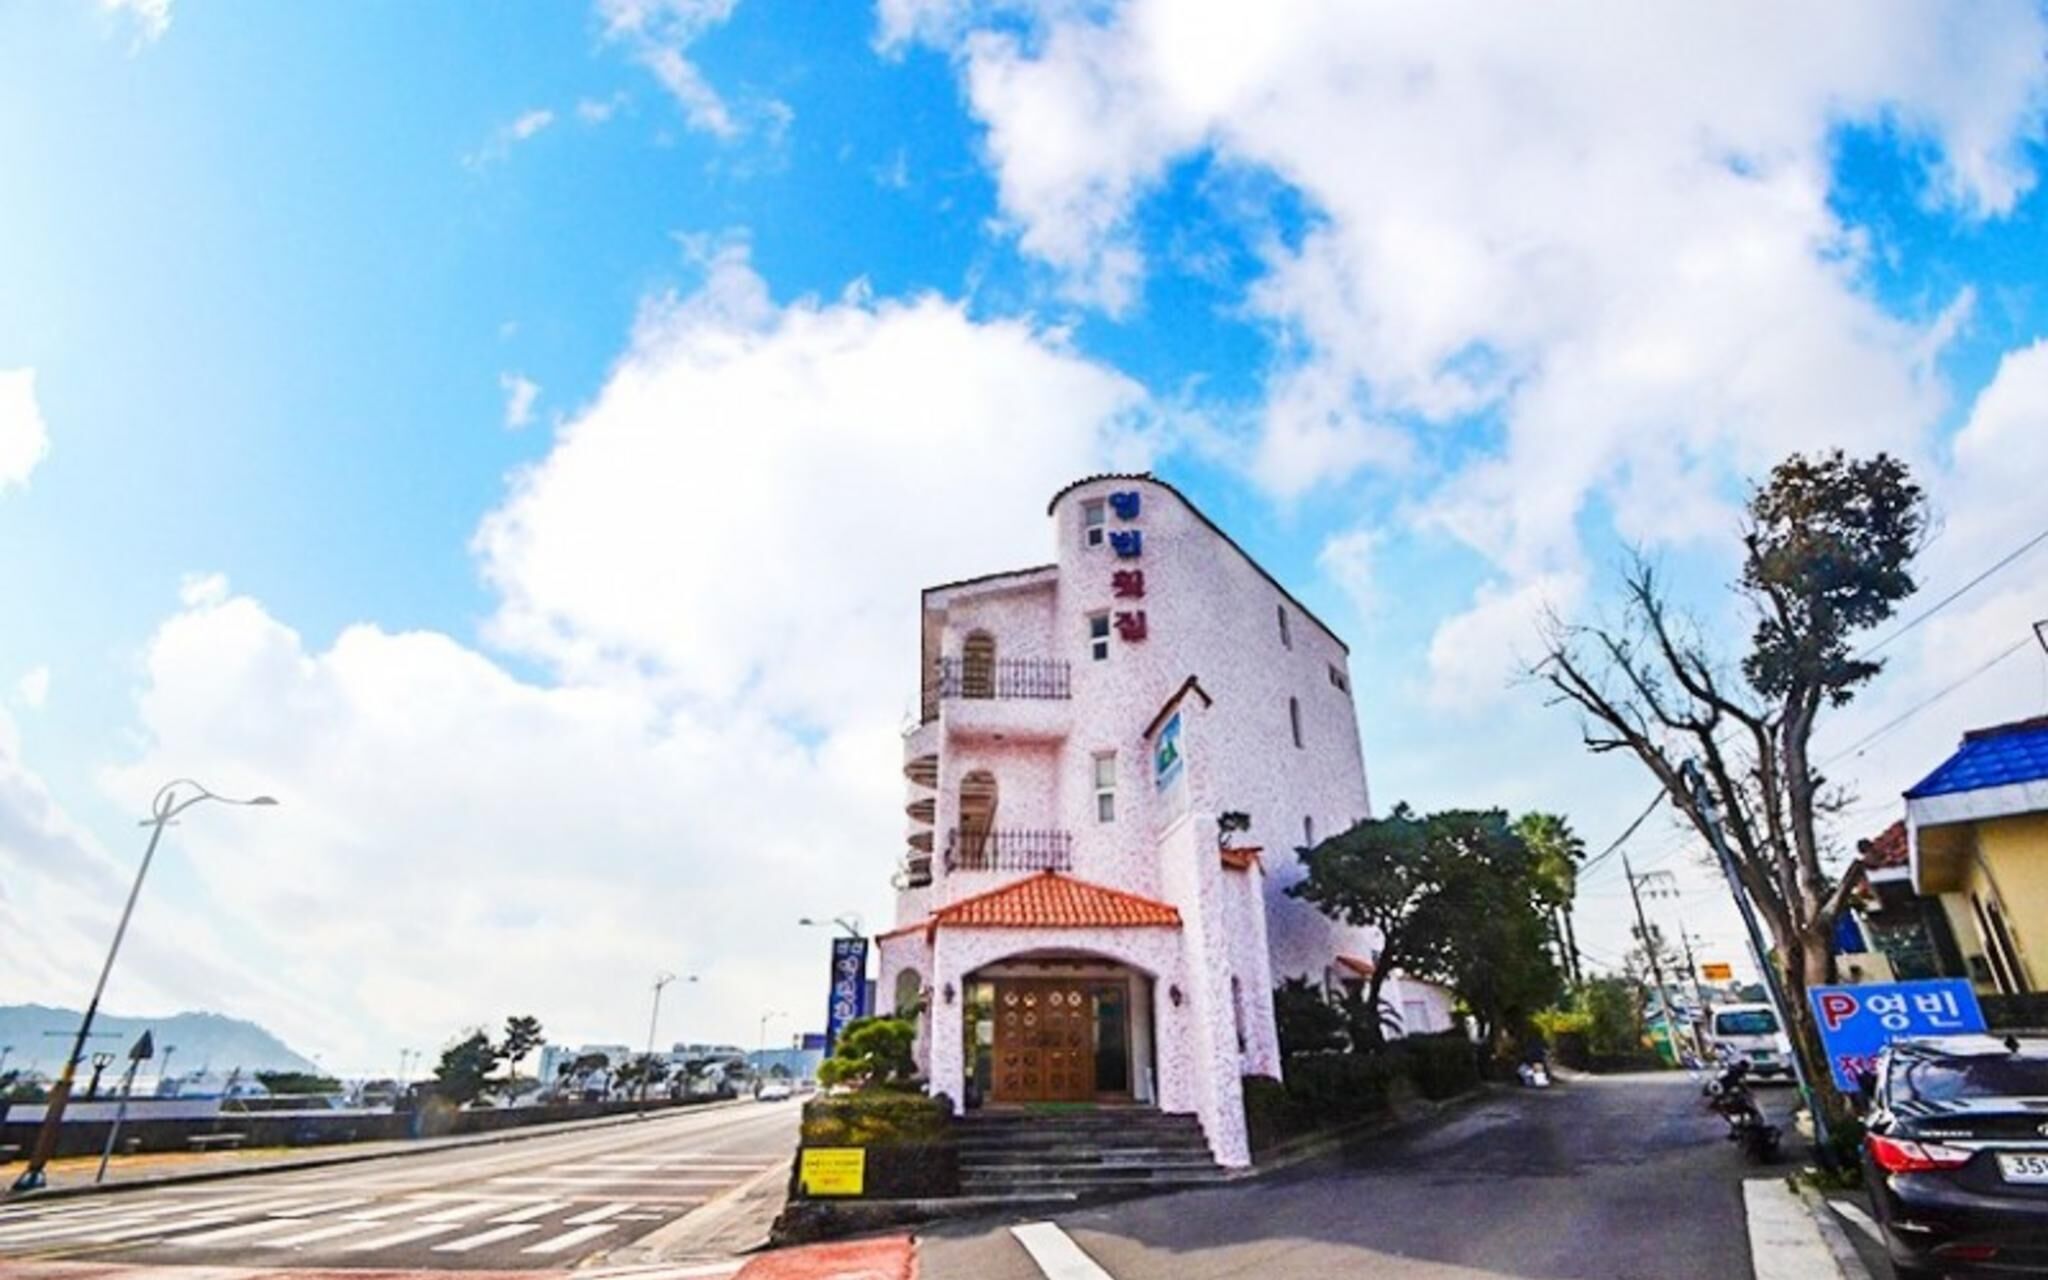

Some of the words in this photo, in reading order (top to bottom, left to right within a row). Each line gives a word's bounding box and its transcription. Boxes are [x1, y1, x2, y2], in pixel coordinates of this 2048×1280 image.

[1108, 490, 1147, 643] 영빈횟집
[1818, 993, 1860, 1031] P
[1866, 991, 1964, 1031] 영빈
